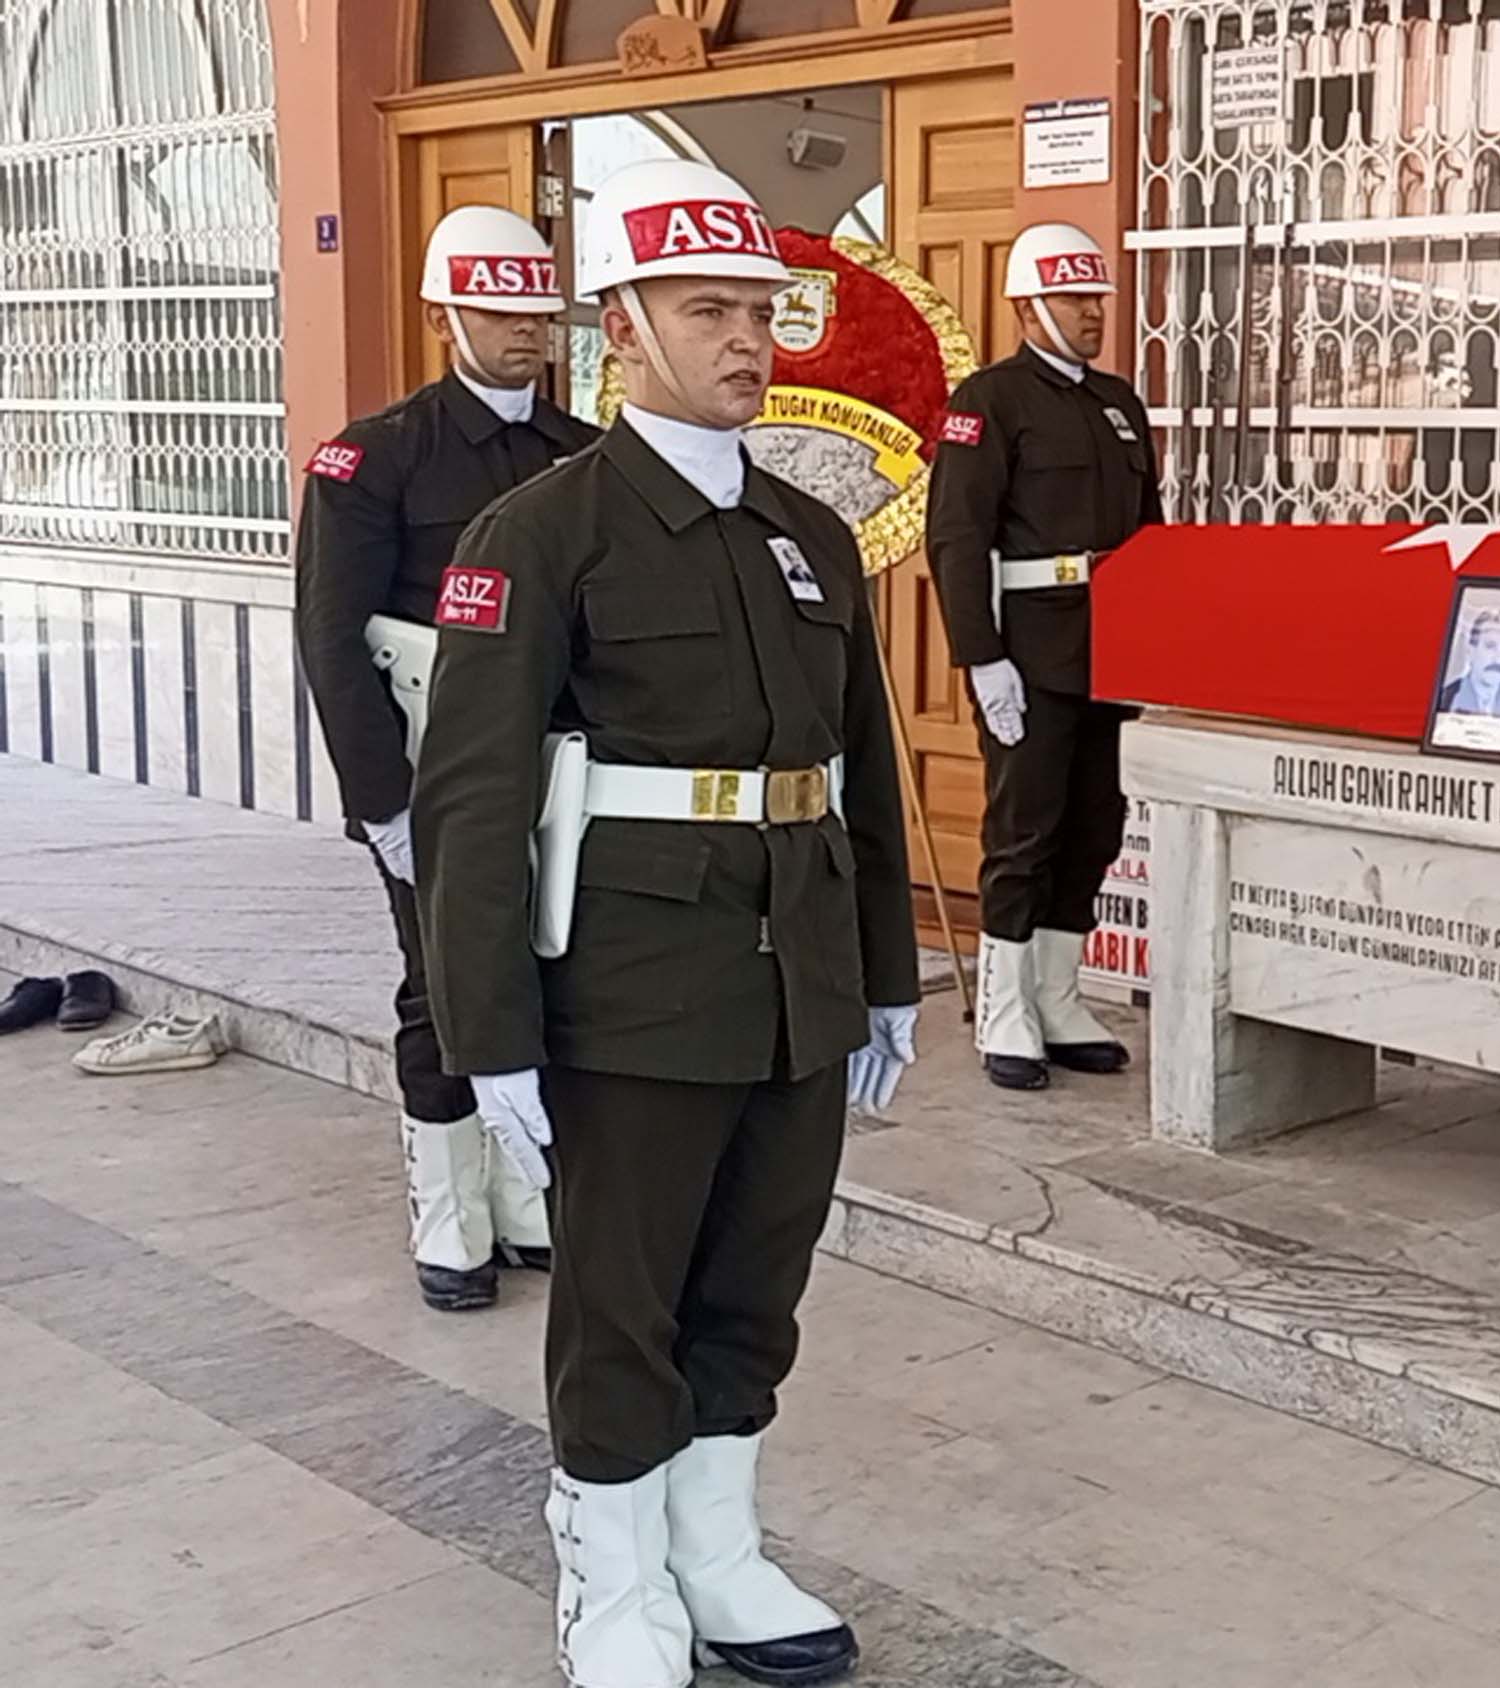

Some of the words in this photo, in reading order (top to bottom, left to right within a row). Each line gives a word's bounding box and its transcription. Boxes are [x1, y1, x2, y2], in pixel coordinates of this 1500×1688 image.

[770, 394, 818, 419] TUGAY
[819, 399, 913, 458] KOMUTANLIĞI
[1274, 755, 1336, 801] ALLAH
[1398, 771, 1494, 824] RAHMET
